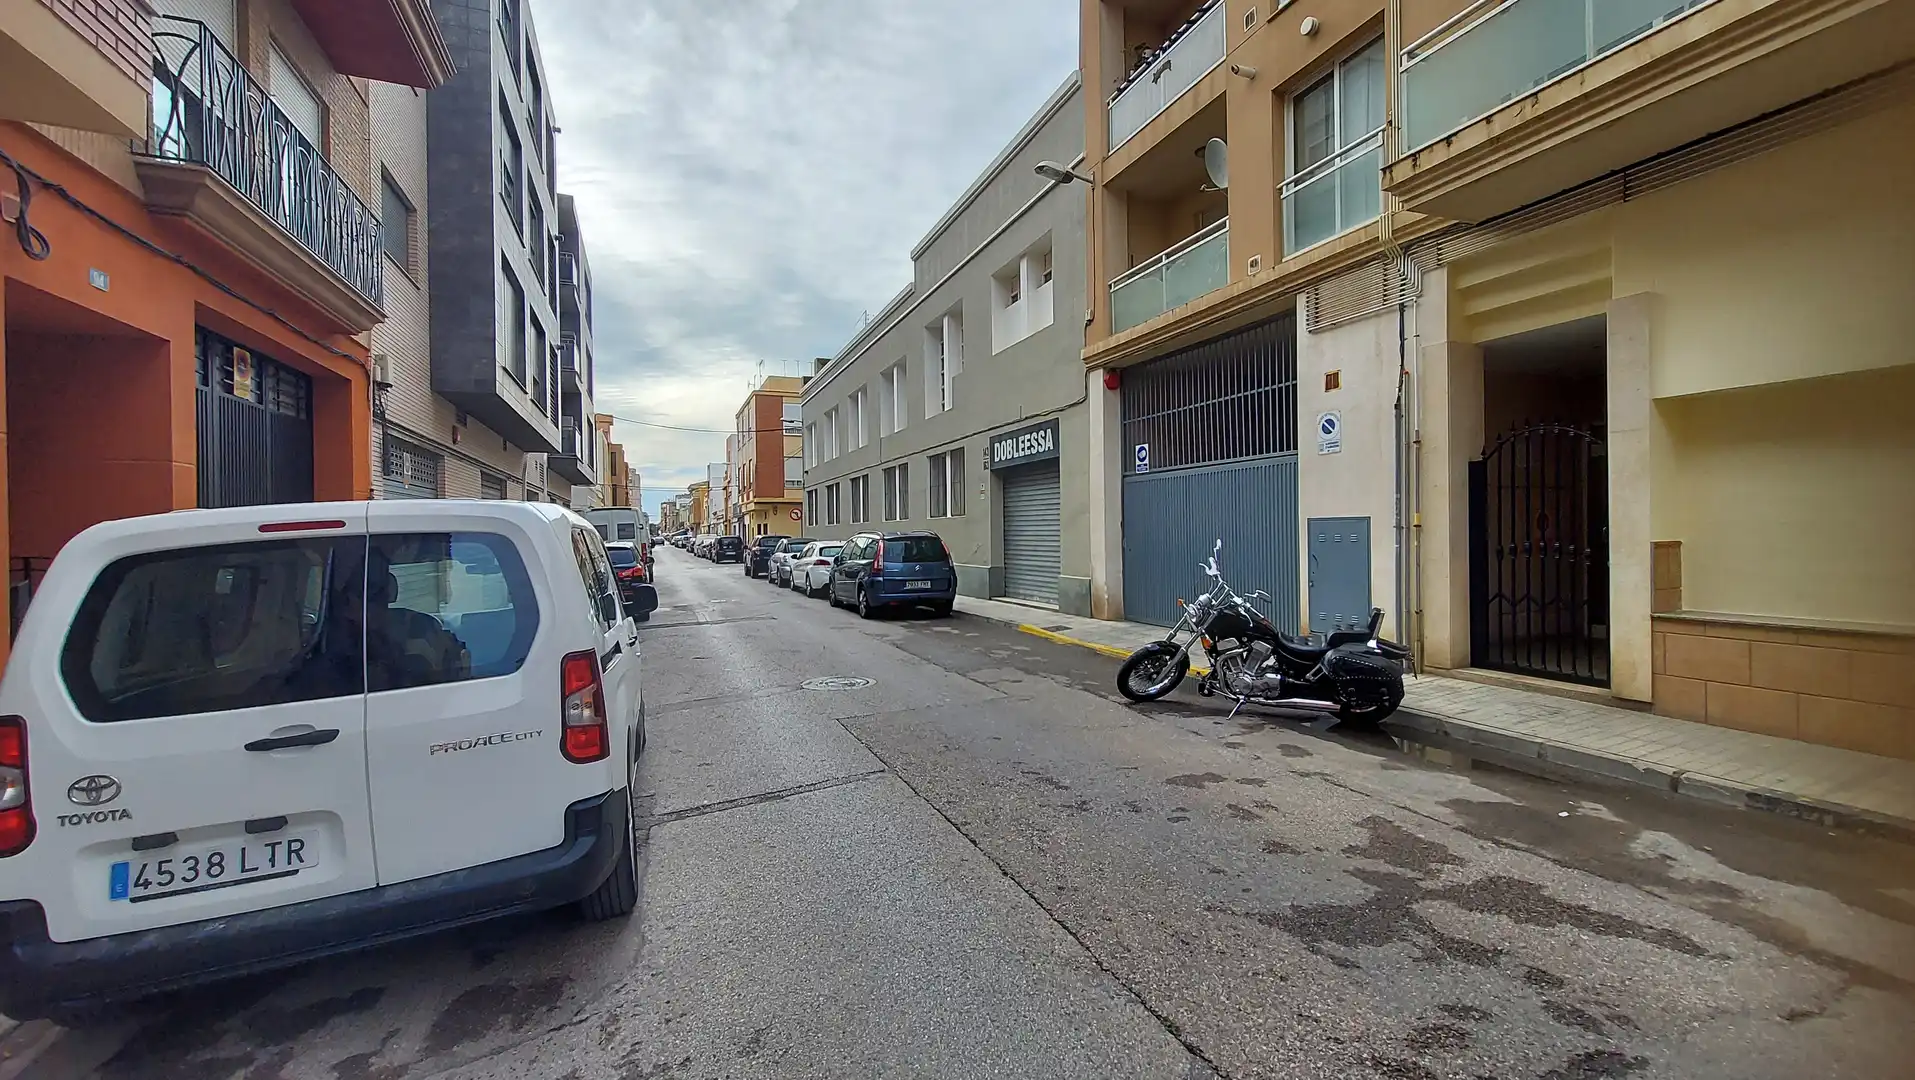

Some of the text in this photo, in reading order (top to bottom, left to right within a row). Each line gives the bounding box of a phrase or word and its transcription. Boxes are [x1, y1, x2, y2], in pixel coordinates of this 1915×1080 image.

[994, 428, 1054, 463] DOBLEESSA
[430, 730, 543, 755] PROACE CITY
[57, 808, 133, 827] TOYOTA
[133, 851, 225, 891] 4538
[240, 838, 305, 874] LTR
